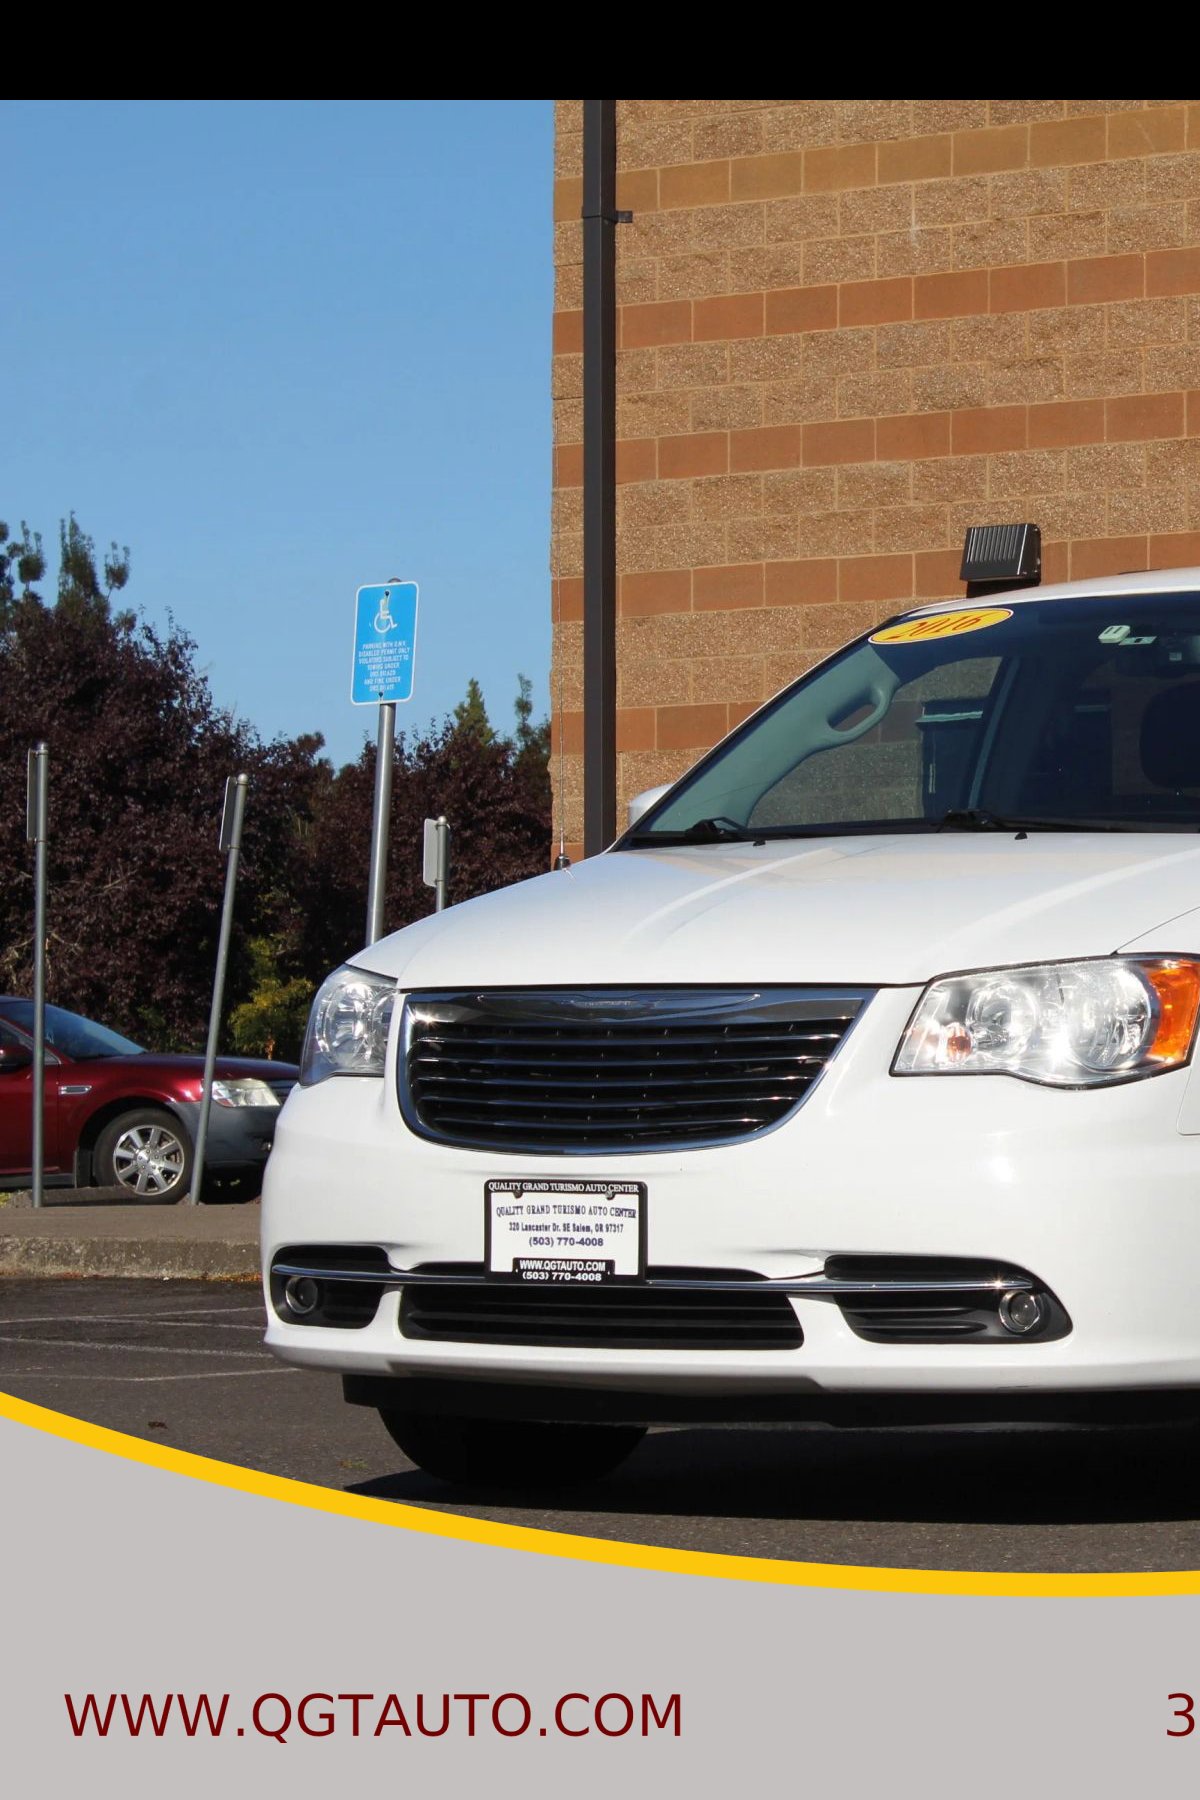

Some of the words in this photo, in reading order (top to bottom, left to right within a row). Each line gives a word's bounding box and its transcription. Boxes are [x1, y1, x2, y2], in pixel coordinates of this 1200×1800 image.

[882, 611, 1000, 641] 2016
[488, 1182, 522, 1191] QUALITY
[522, 1182, 549, 1191] GRAND
[550, 1183, 585, 1192] TURISMO
[585, 1183, 607, 1192] AUTO
[608, 1184, 639, 1193] CENTER
[496, 1205, 524, 1217] QUALITY
[526, 1204, 550, 1215] GRAND
[552, 1204, 586, 1215] TURISMO
[588, 1205, 608, 1216] AUTO
[609, 1207, 637, 1218] CENTER
[509, 1221, 520, 1231] 320
[521, 1222, 551, 1232] Lancaster
[552, 1222, 561, 1232] Dr.
[562, 1223, 570, 1232] SE
[572, 1223, 593, 1234] Salem,
[594, 1223, 604, 1233] OR
[605, 1223, 624, 1233] 97317
[529, 1236, 554, 1247] (503)
[557, 1236, 604, 1247] 770-4008
[519, 1259, 606, 1272] WWW.QGTAUTO.COM
[522, 1271, 549, 1281] (503)
[551, 1272, 602, 1282] 770-4008
